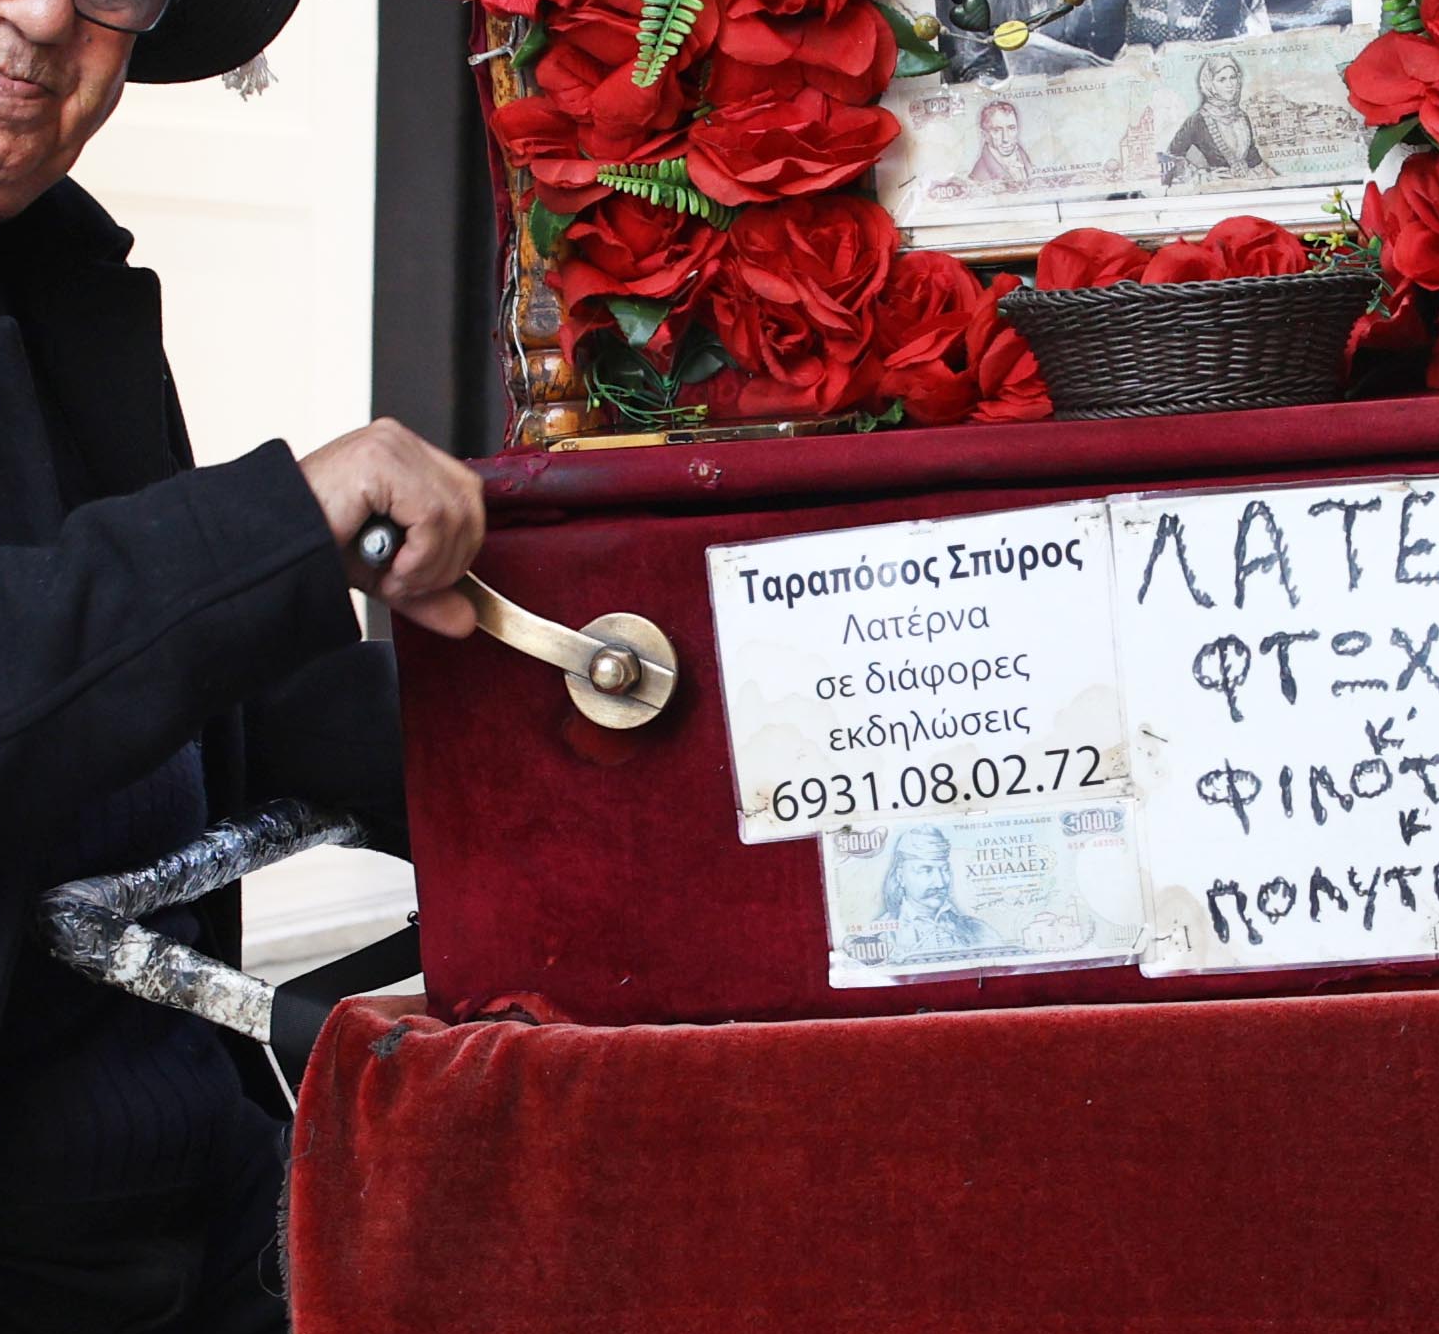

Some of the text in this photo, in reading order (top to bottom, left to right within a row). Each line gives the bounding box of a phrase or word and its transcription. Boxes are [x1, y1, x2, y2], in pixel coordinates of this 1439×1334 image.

[739, 537, 1084, 609] Ταραπόσος Σπύρος
[842, 605, 990, 645] Λατέρνα
[816, 653, 1031, 700] σε διάφορες
[829, 706, 1031, 751] εκδηλώσεις
[771, 745, 1106, 821] 6931.08.02.72
[838, 832, 881, 852] 5000
[976, 845, 1038, 862] ΠΕΝΤΕ
[965, 858, 1049, 878] ΧΙΛΙΑΔΕΣ
